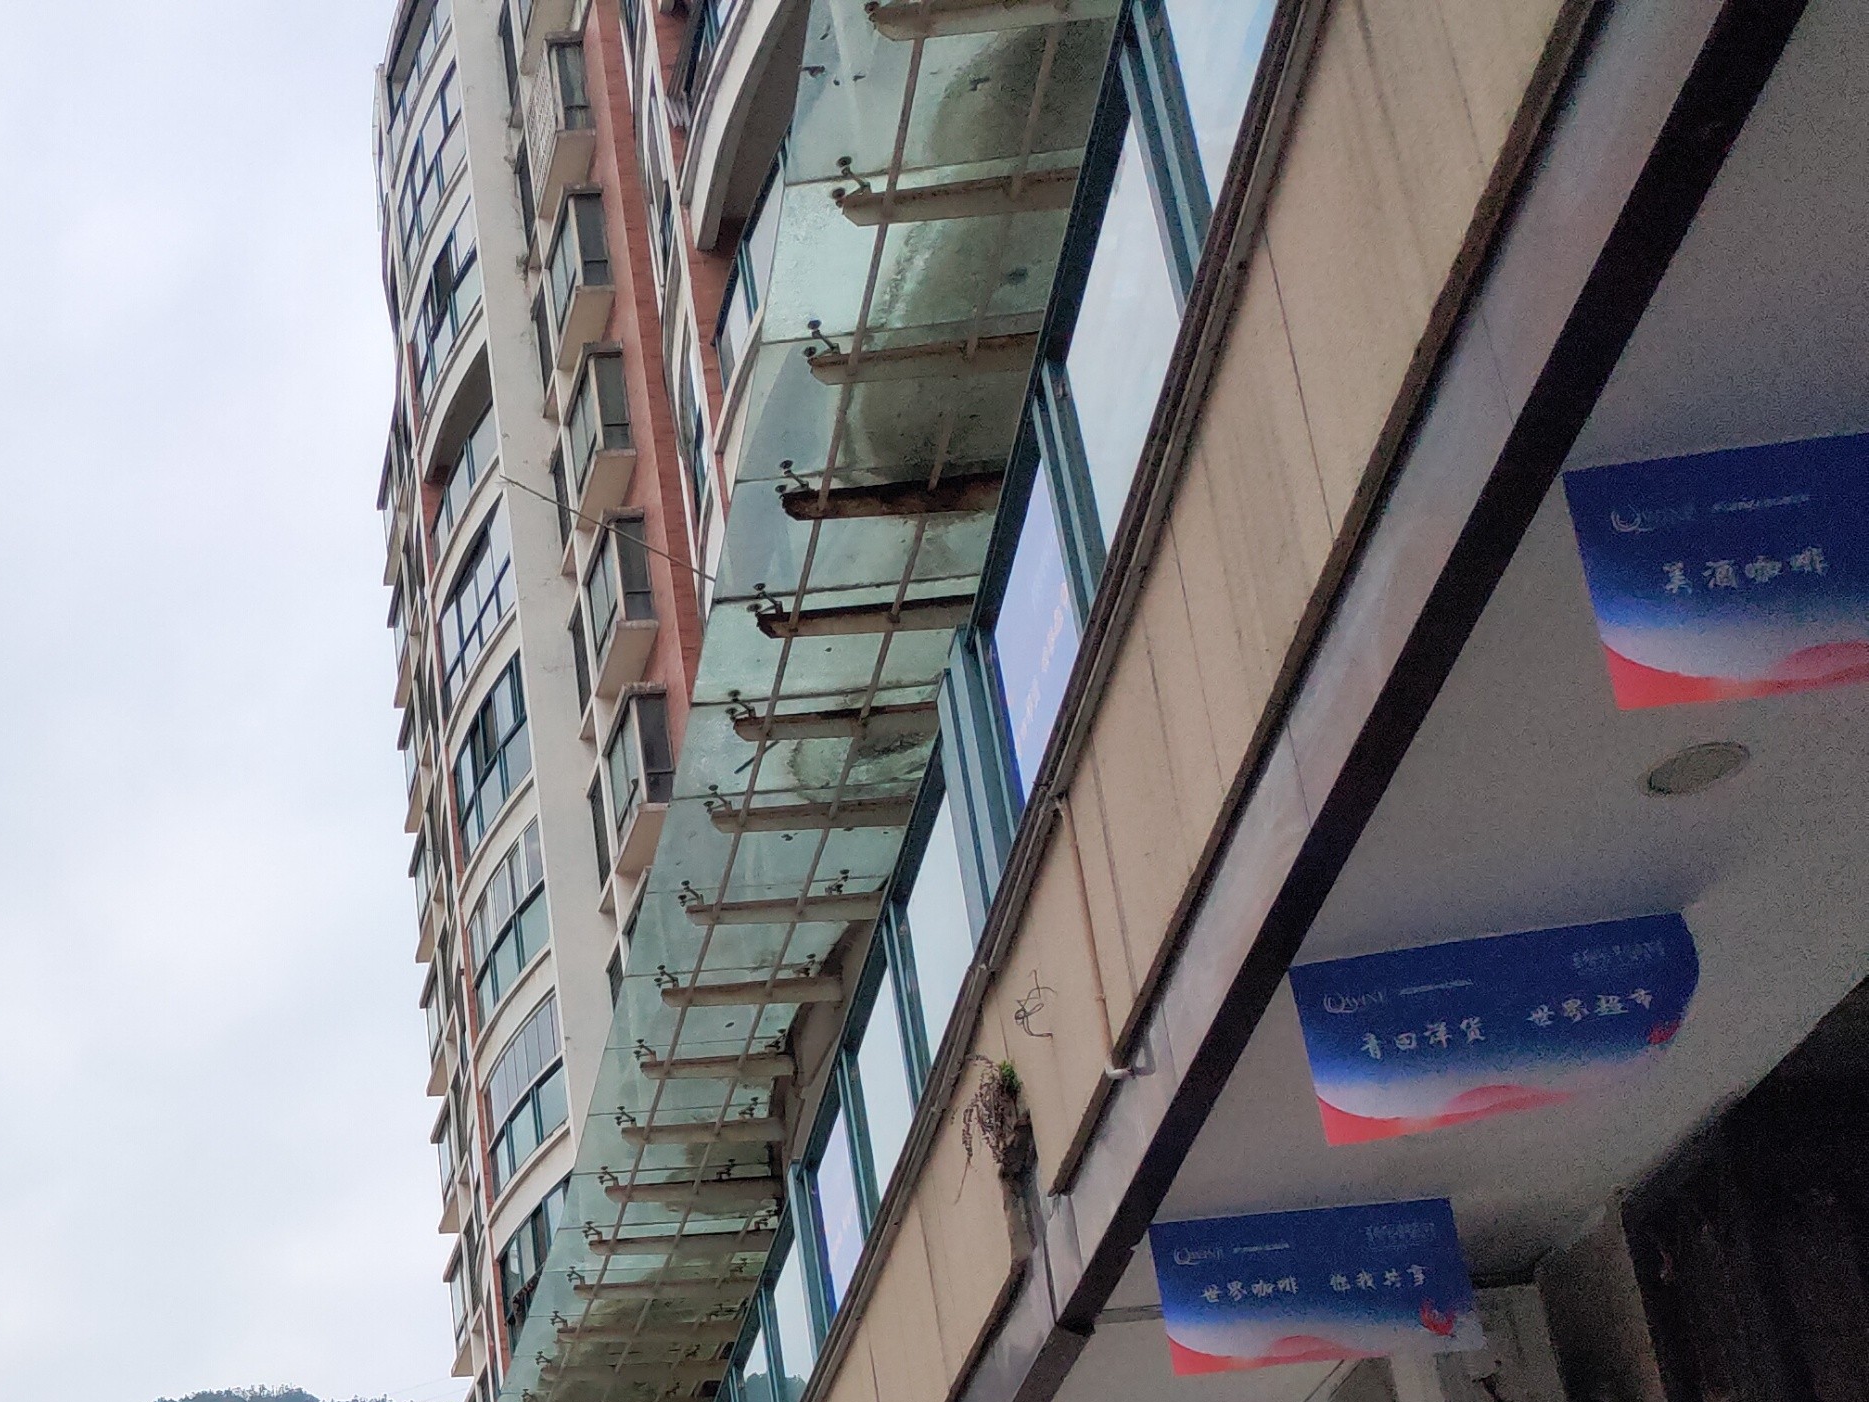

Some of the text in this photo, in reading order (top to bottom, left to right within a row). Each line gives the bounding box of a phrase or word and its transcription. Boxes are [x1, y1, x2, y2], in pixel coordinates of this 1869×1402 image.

[1360, 988, 1654, 1060] 青田洋货 世界超市
[1200, 1276, 1299, 1303] 世界咖啡
